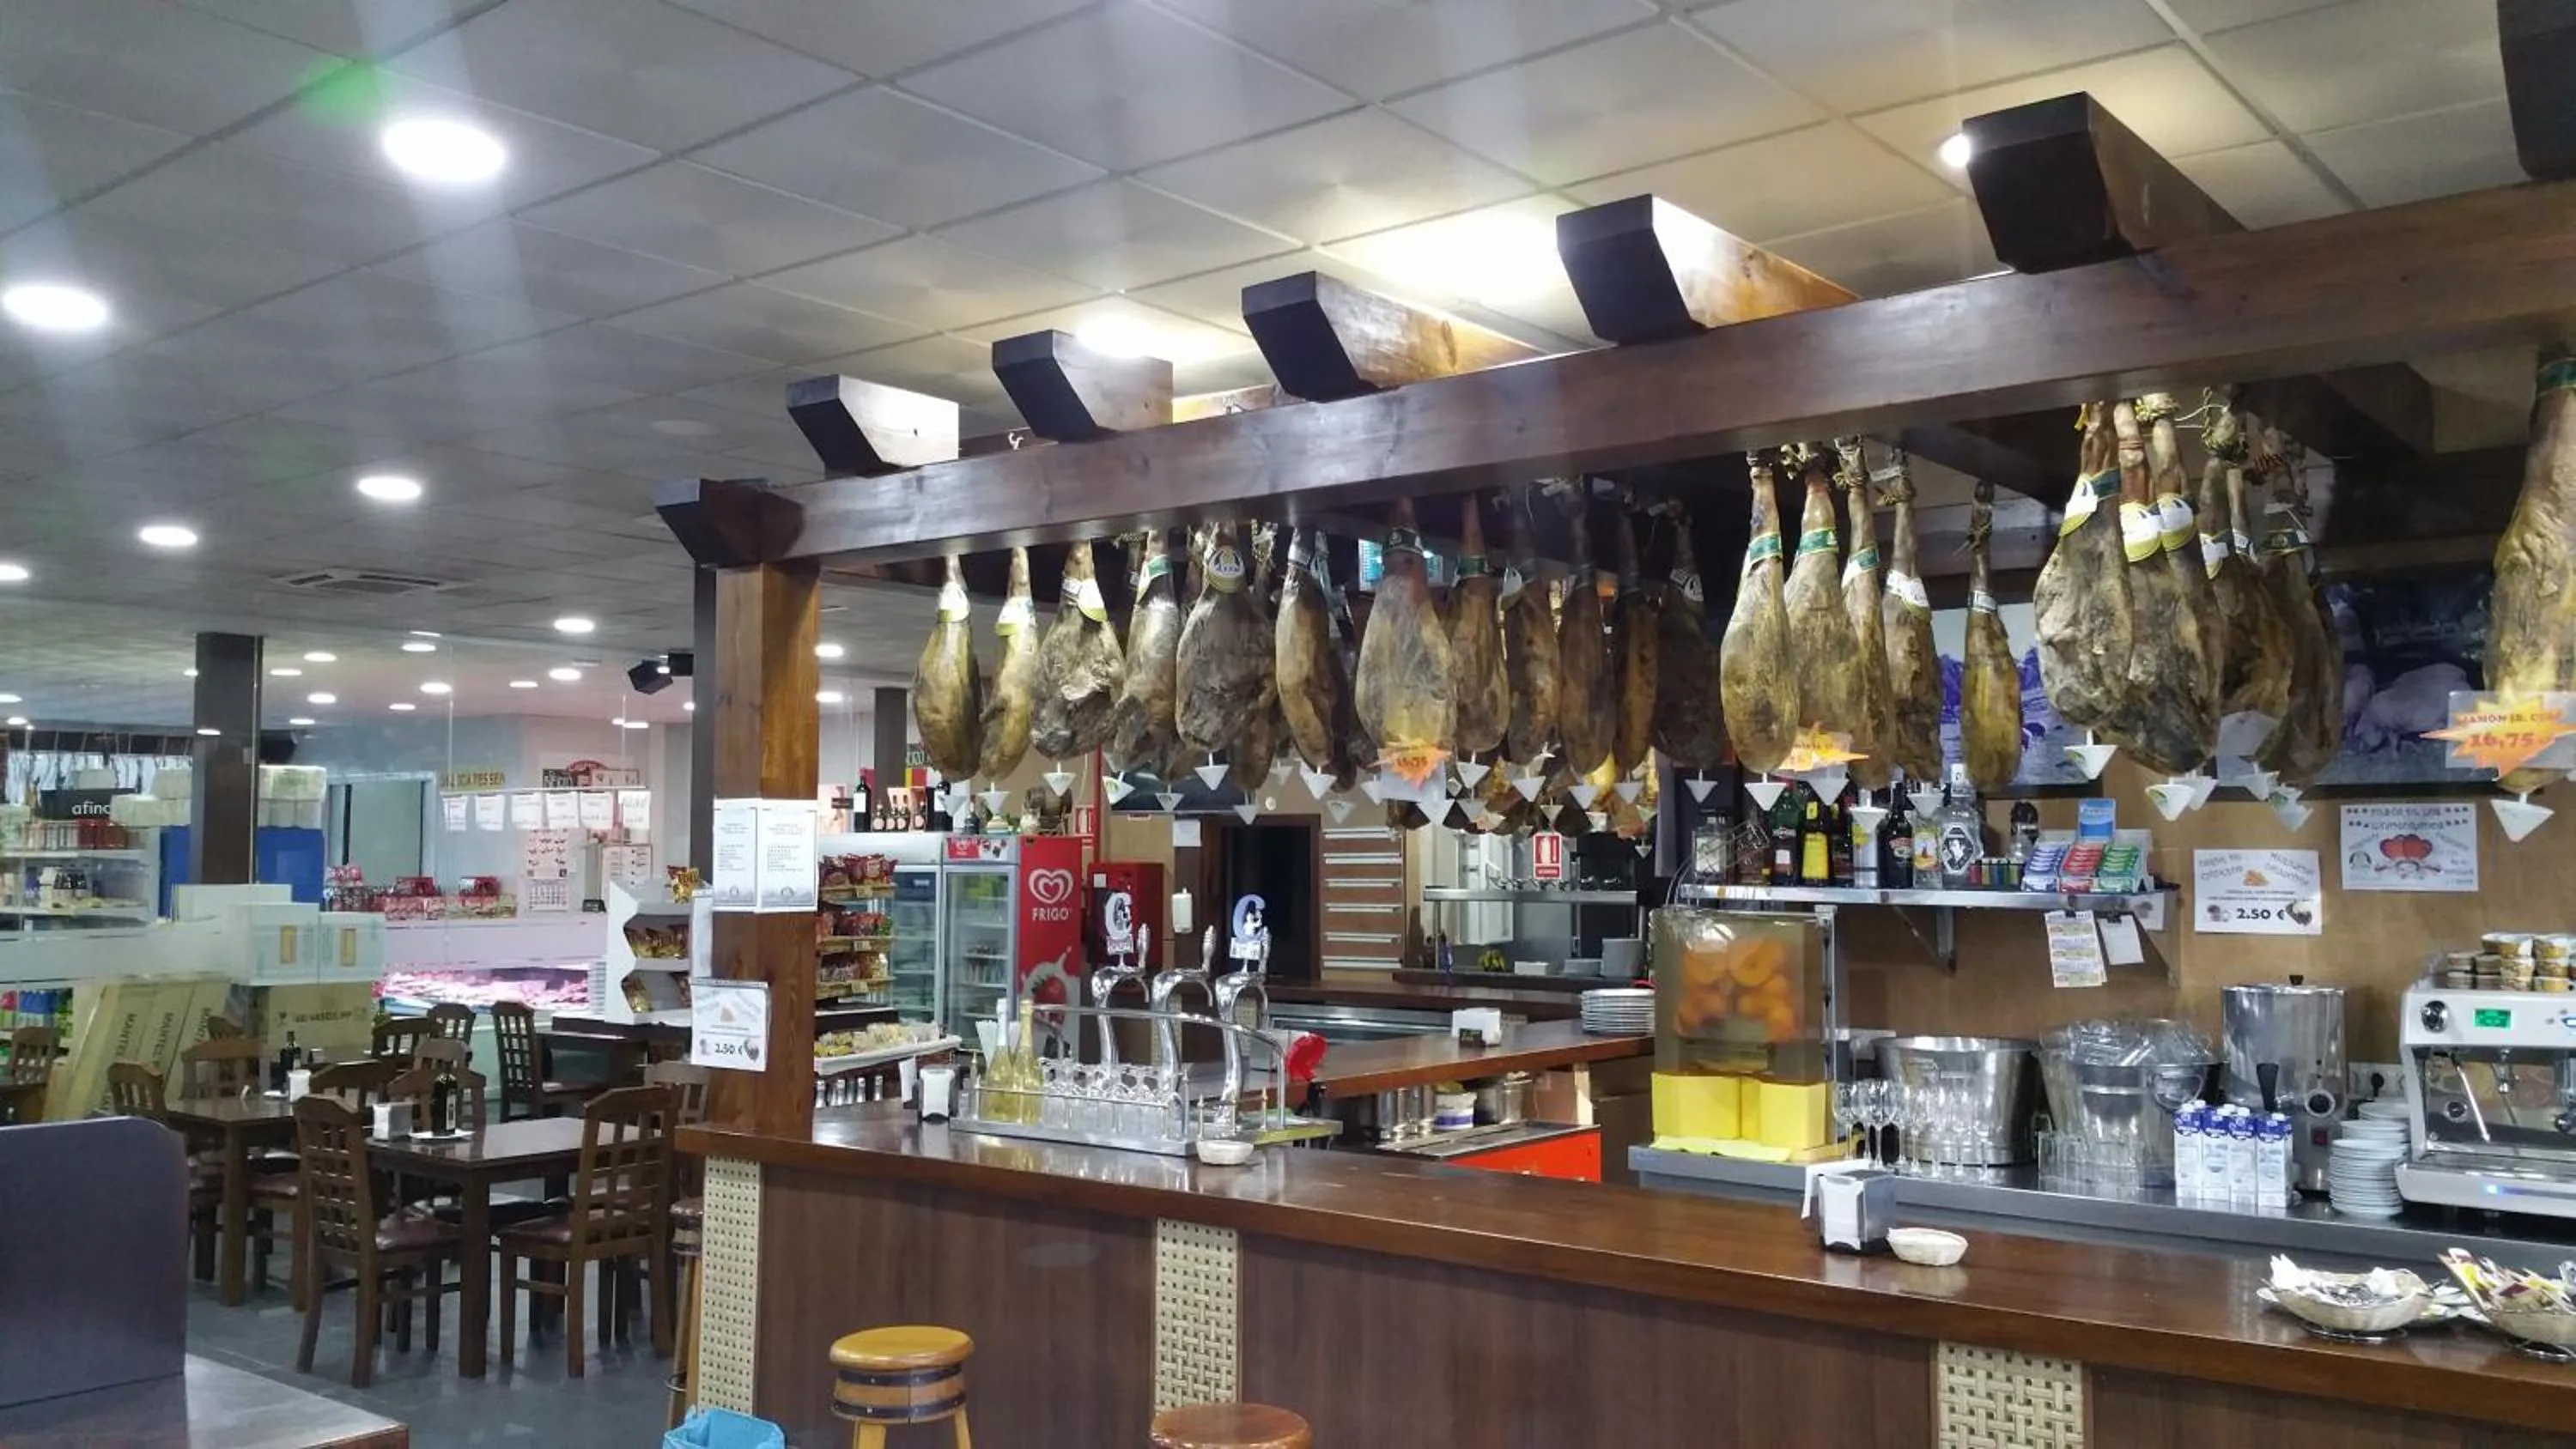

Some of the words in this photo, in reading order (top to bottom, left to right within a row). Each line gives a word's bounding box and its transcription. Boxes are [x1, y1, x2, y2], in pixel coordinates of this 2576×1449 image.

[2470, 732, 2534, 749] 16,75
[1032, 907, 1069, 921] FRIGO
[2236, 907, 2271, 920] 2.50
